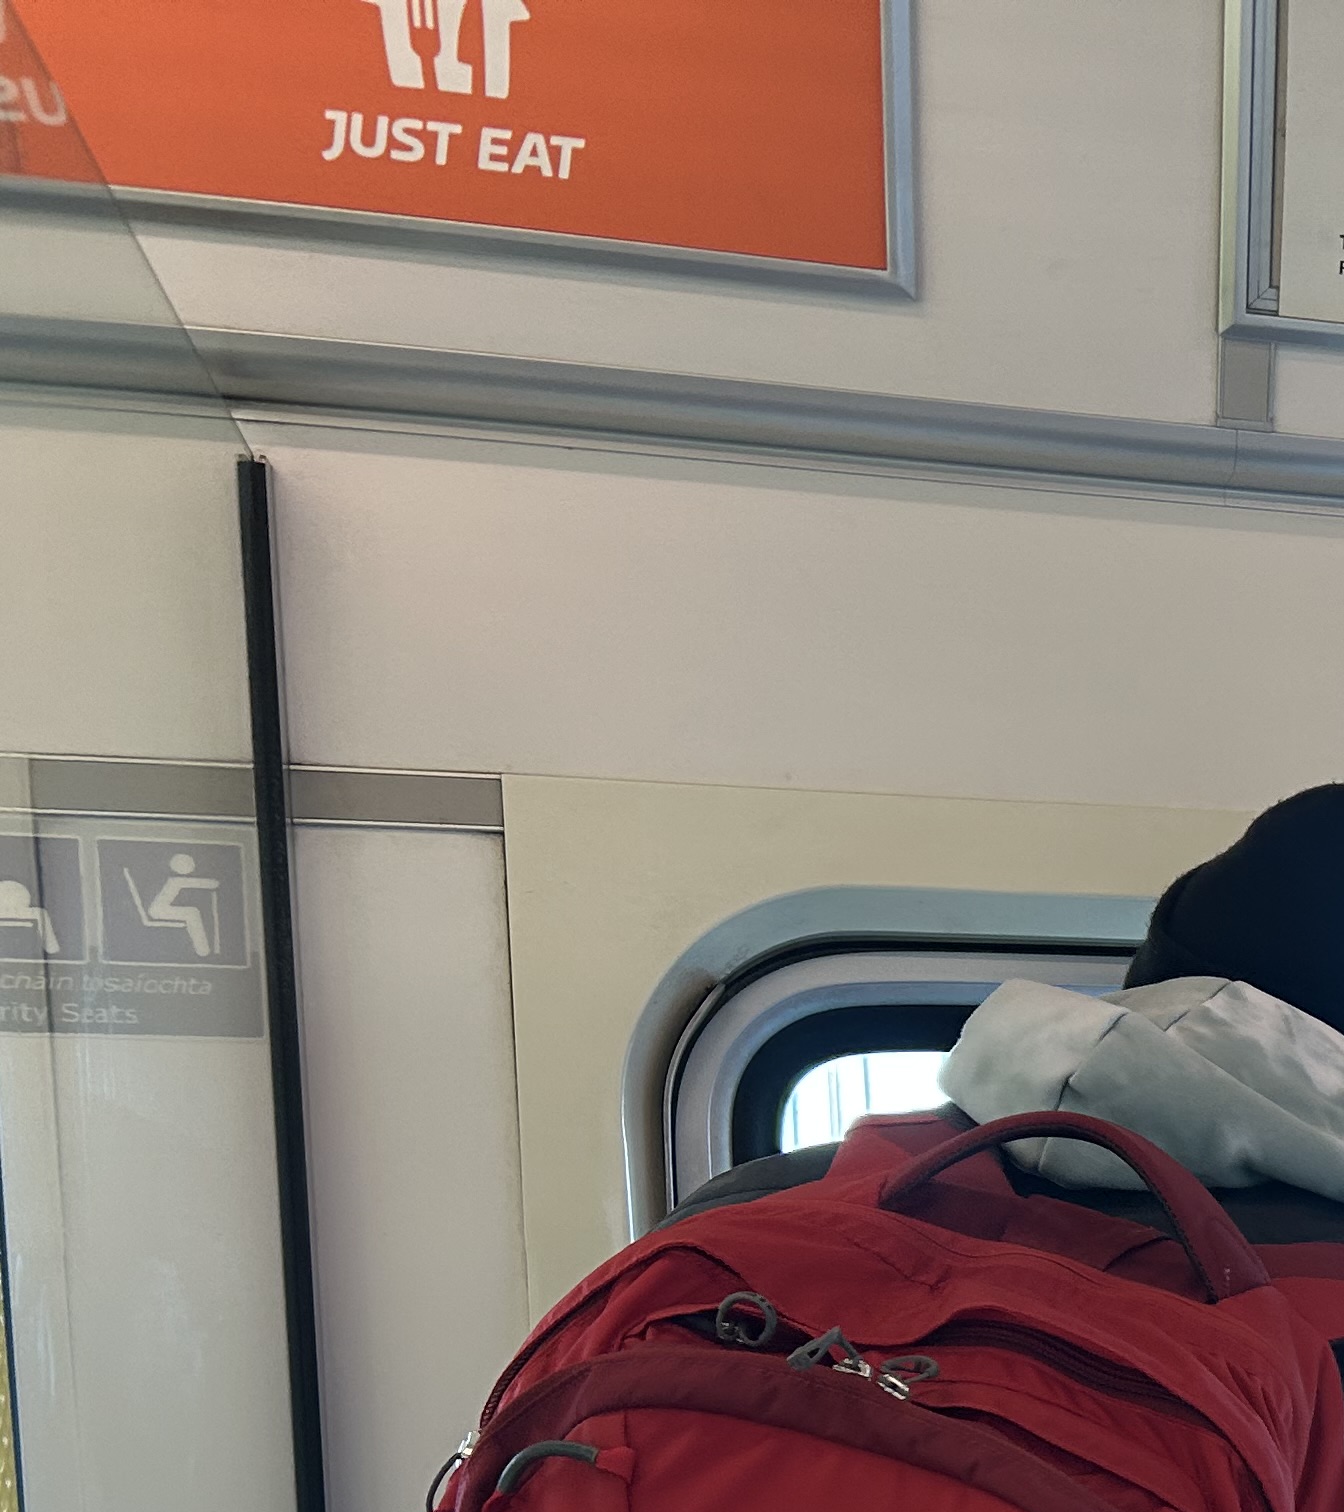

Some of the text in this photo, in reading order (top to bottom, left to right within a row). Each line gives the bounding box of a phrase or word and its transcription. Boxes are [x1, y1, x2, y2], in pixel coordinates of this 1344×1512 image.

[322, 109, 586, 180] JUST EAT
[61, 1002, 140, 1025] Seats
